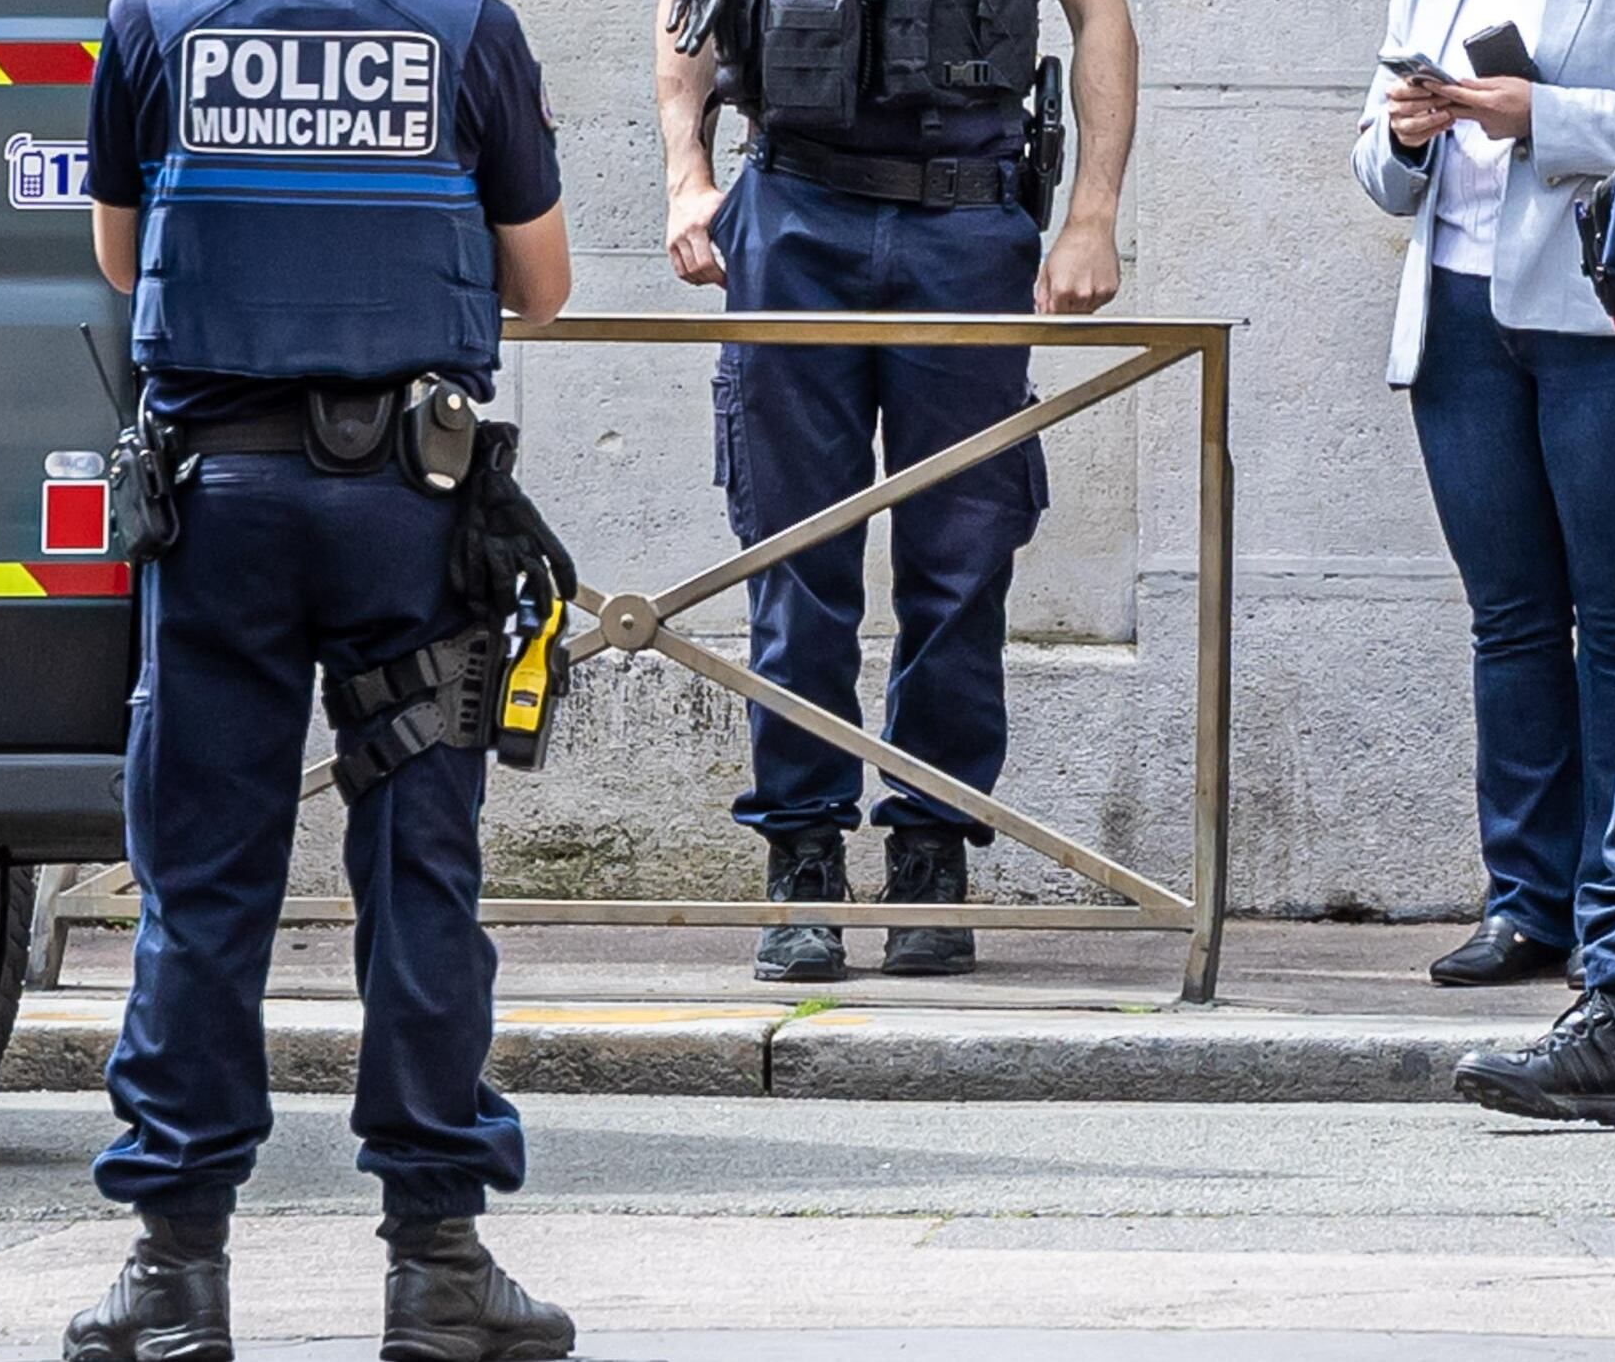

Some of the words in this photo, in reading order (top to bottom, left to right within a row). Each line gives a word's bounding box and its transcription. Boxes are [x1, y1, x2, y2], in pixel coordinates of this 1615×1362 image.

[192, 38, 430, 103] POLICE
[192, 107, 429, 149] MUNICIPALE
[49, 153, 90, 195] 17
